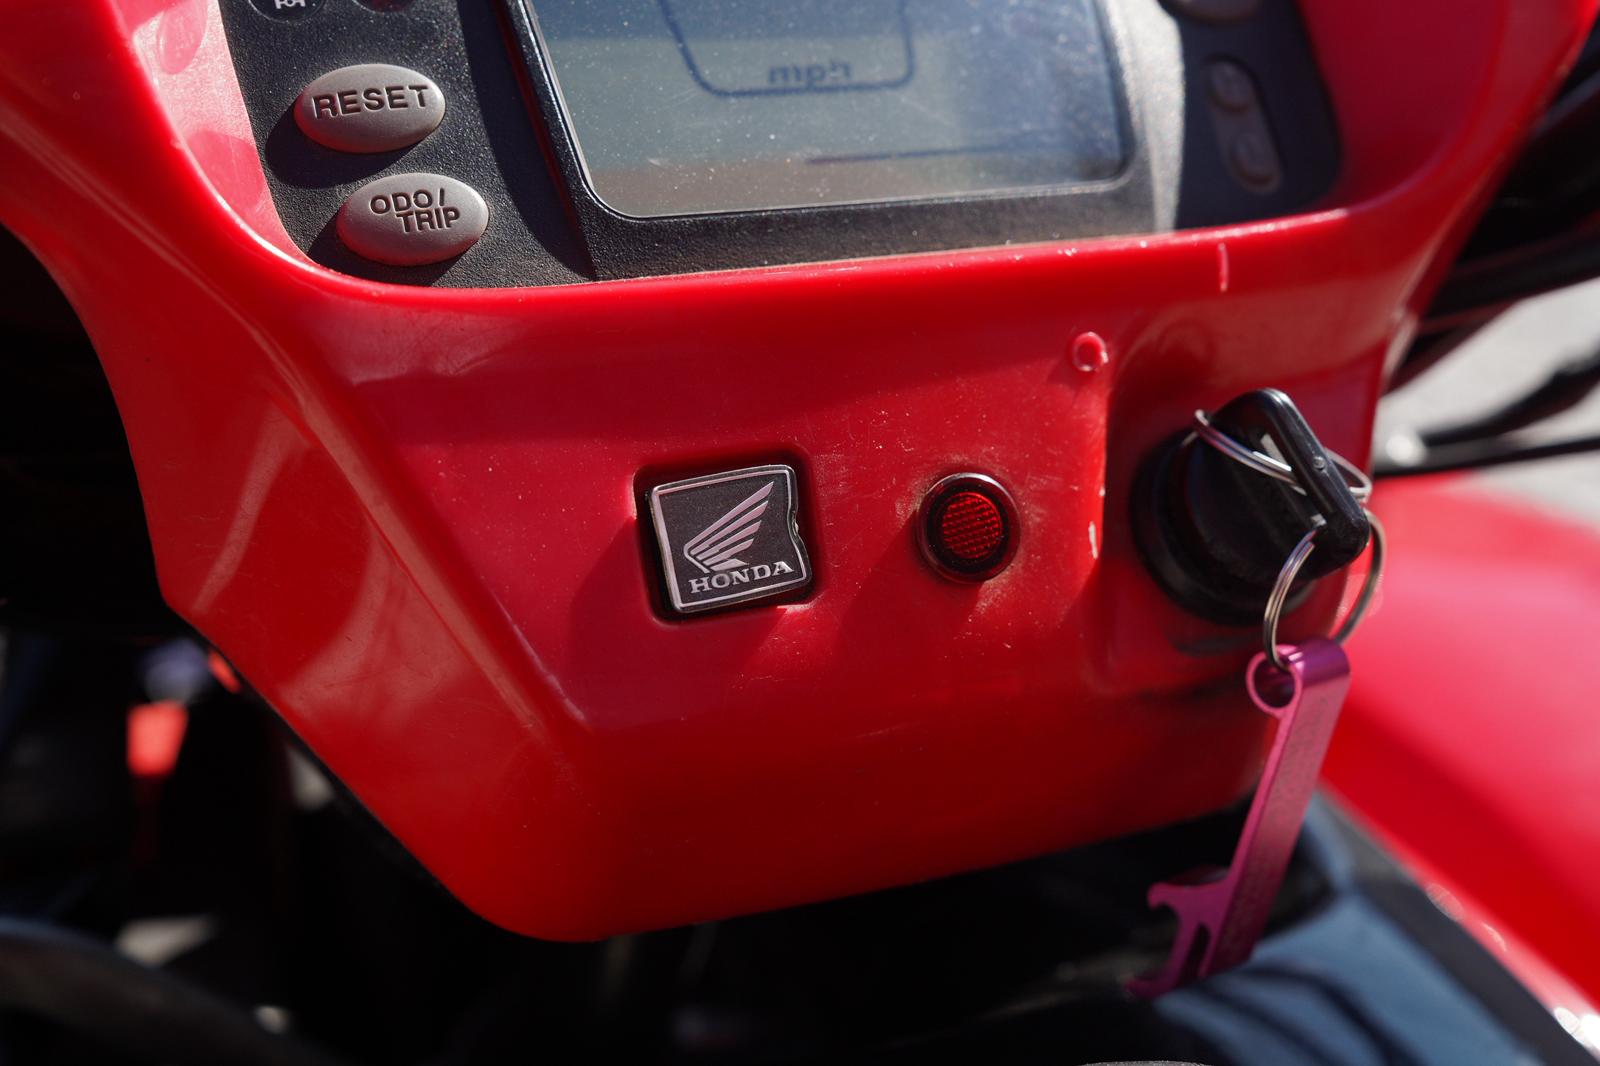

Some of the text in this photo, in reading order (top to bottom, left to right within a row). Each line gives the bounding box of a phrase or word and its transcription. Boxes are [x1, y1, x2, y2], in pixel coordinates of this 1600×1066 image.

[312, 85, 428, 119] RESET
[370, 188, 445, 214] ODO/
[396, 207, 460, 233] TRIP
[688, 561, 794, 594] HONDA
